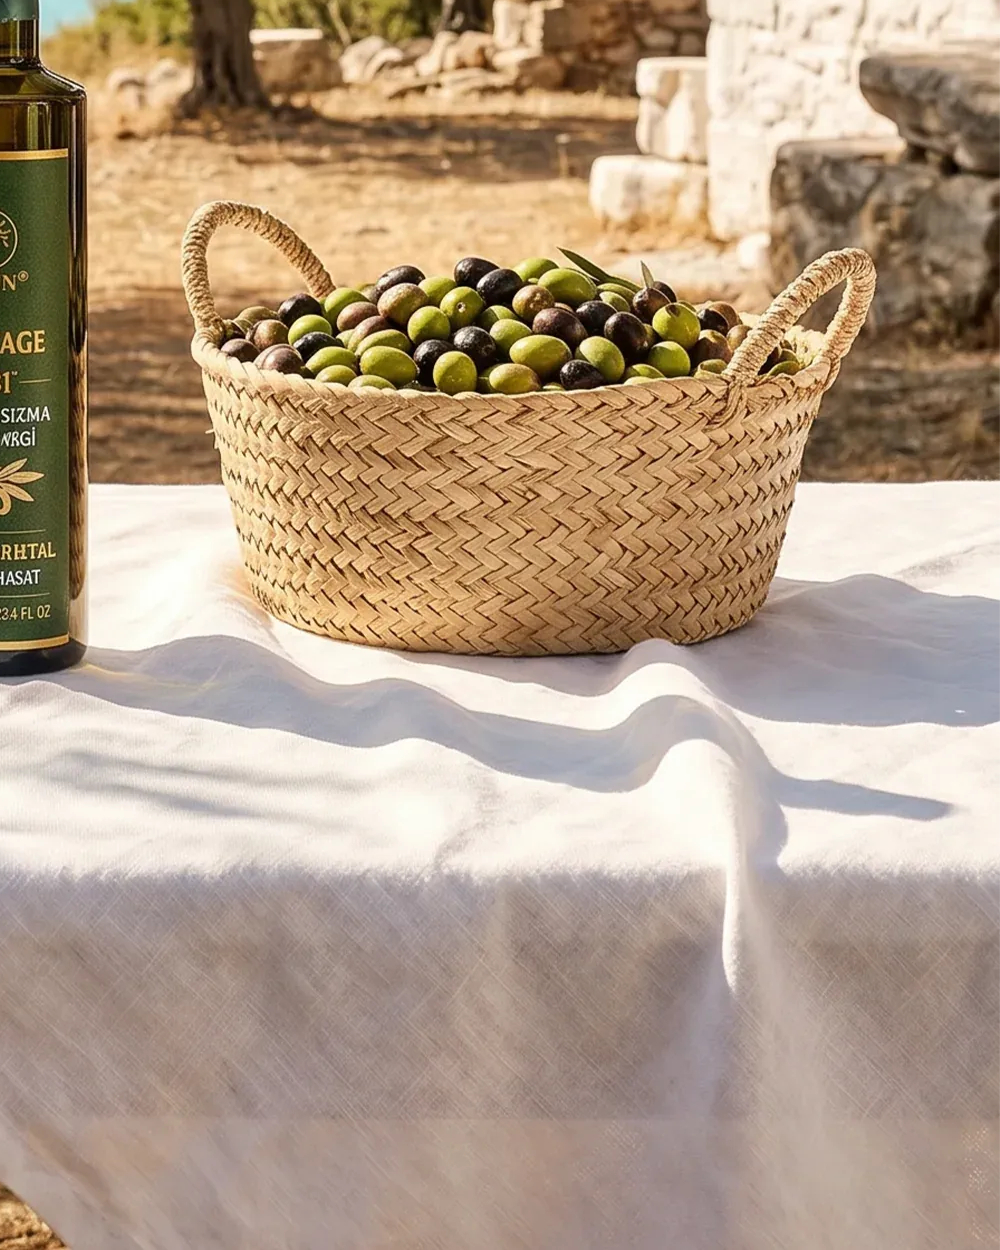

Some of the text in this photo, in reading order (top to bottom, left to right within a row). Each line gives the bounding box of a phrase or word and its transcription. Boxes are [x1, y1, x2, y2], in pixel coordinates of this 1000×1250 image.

[1, 406, 51, 423] SIZMA
[21, 607, 34, 620] FL
[37, 605, 51, 618] OZ
